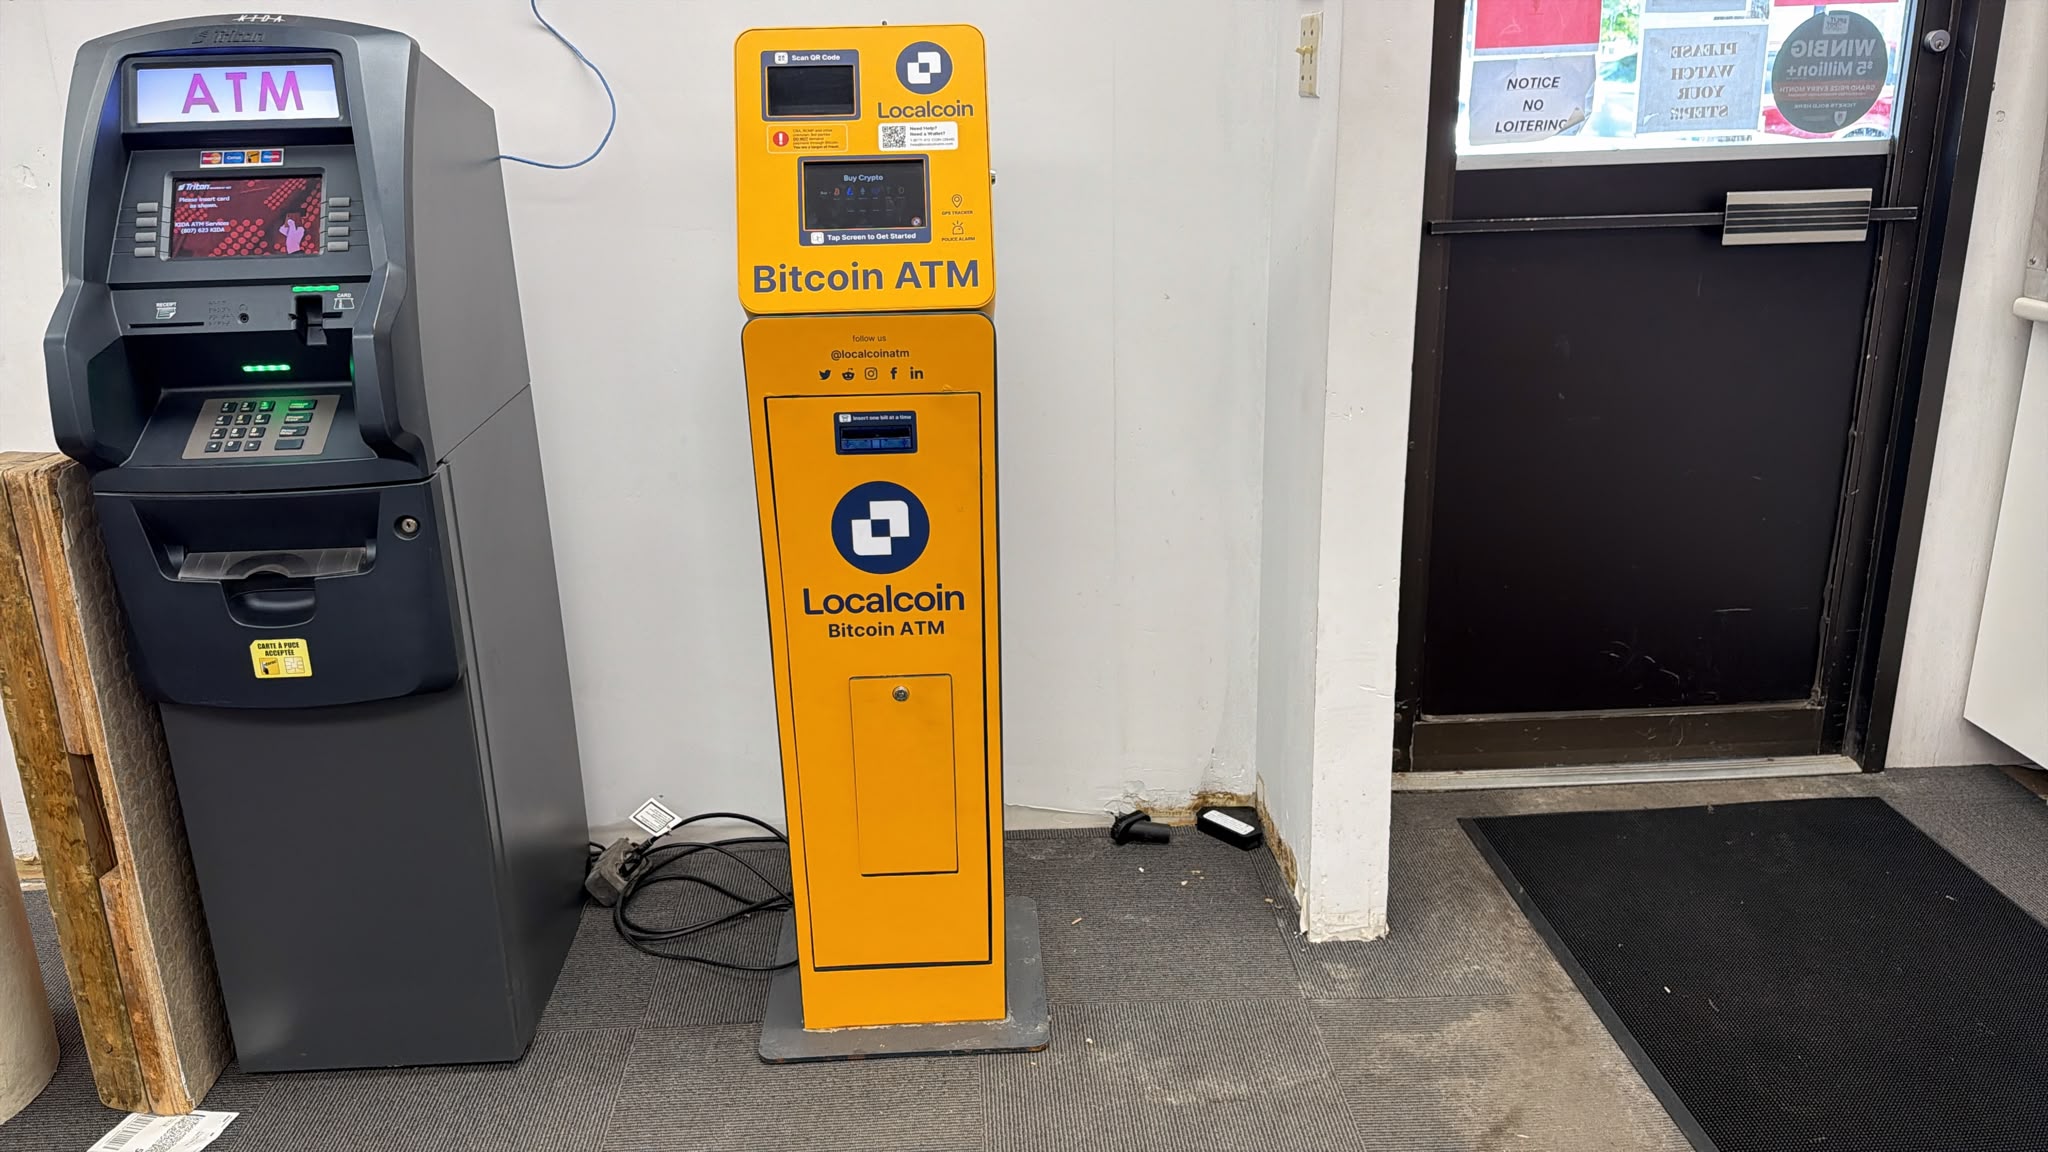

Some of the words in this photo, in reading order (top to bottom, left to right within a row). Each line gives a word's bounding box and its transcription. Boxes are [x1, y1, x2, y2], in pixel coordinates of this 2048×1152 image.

[1506, 77, 1561, 90] NOTICE
[181, 70, 304, 114] ATM
[877, 99, 974, 119] Localcoin
[1522, 99, 1544, 112] NO
[843, 174, 858, 183] Buy
[858, 174, 884, 183] Crypto
[827, 233, 840, 242] Tap
[841, 233, 867, 241] Screen
[876, 232, 889, 240] Get
[890, 232, 917, 240] Started
[754, 262, 883, 293] Bitcoin
[895, 260, 979, 289] ATM
[852, 334, 876, 342] follow
[830, 349, 910, 361] @localcoinatm
[803, 583, 965, 615] Localcoin
[828, 622, 894, 638] Bitcoin
[900, 620, 945, 635] ATM
[257, 642, 277, 650] CARTE
[278, 641, 283, 649] À
[284, 641, 300, 649] PUCE
[265, 649, 295, 657] ACCEPTÉE
